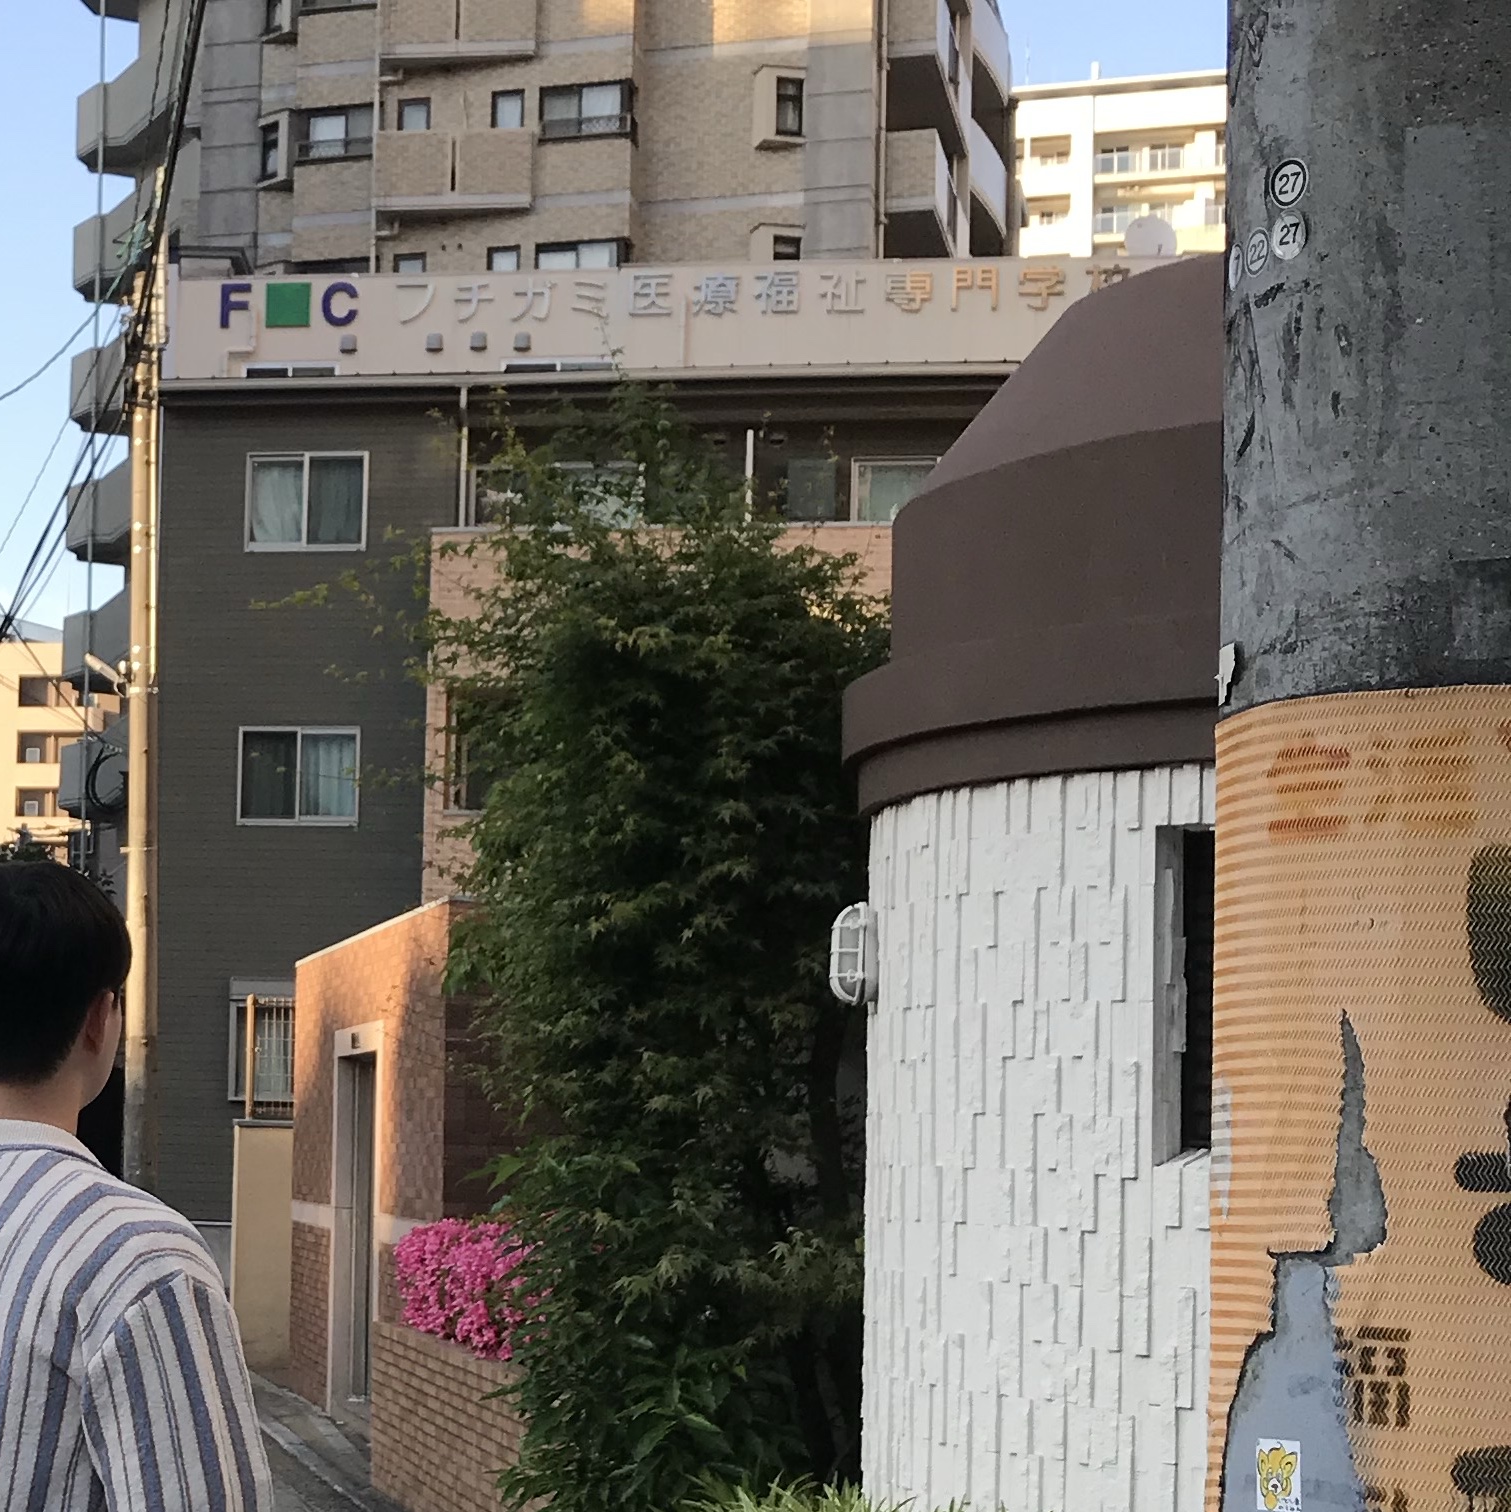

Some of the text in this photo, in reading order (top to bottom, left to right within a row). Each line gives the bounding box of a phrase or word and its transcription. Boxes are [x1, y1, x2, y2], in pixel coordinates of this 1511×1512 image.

[1278, 171, 1301, 196] 27
[1279, 222, 1301, 246] 27
[1249, 240, 1266, 265] 22
